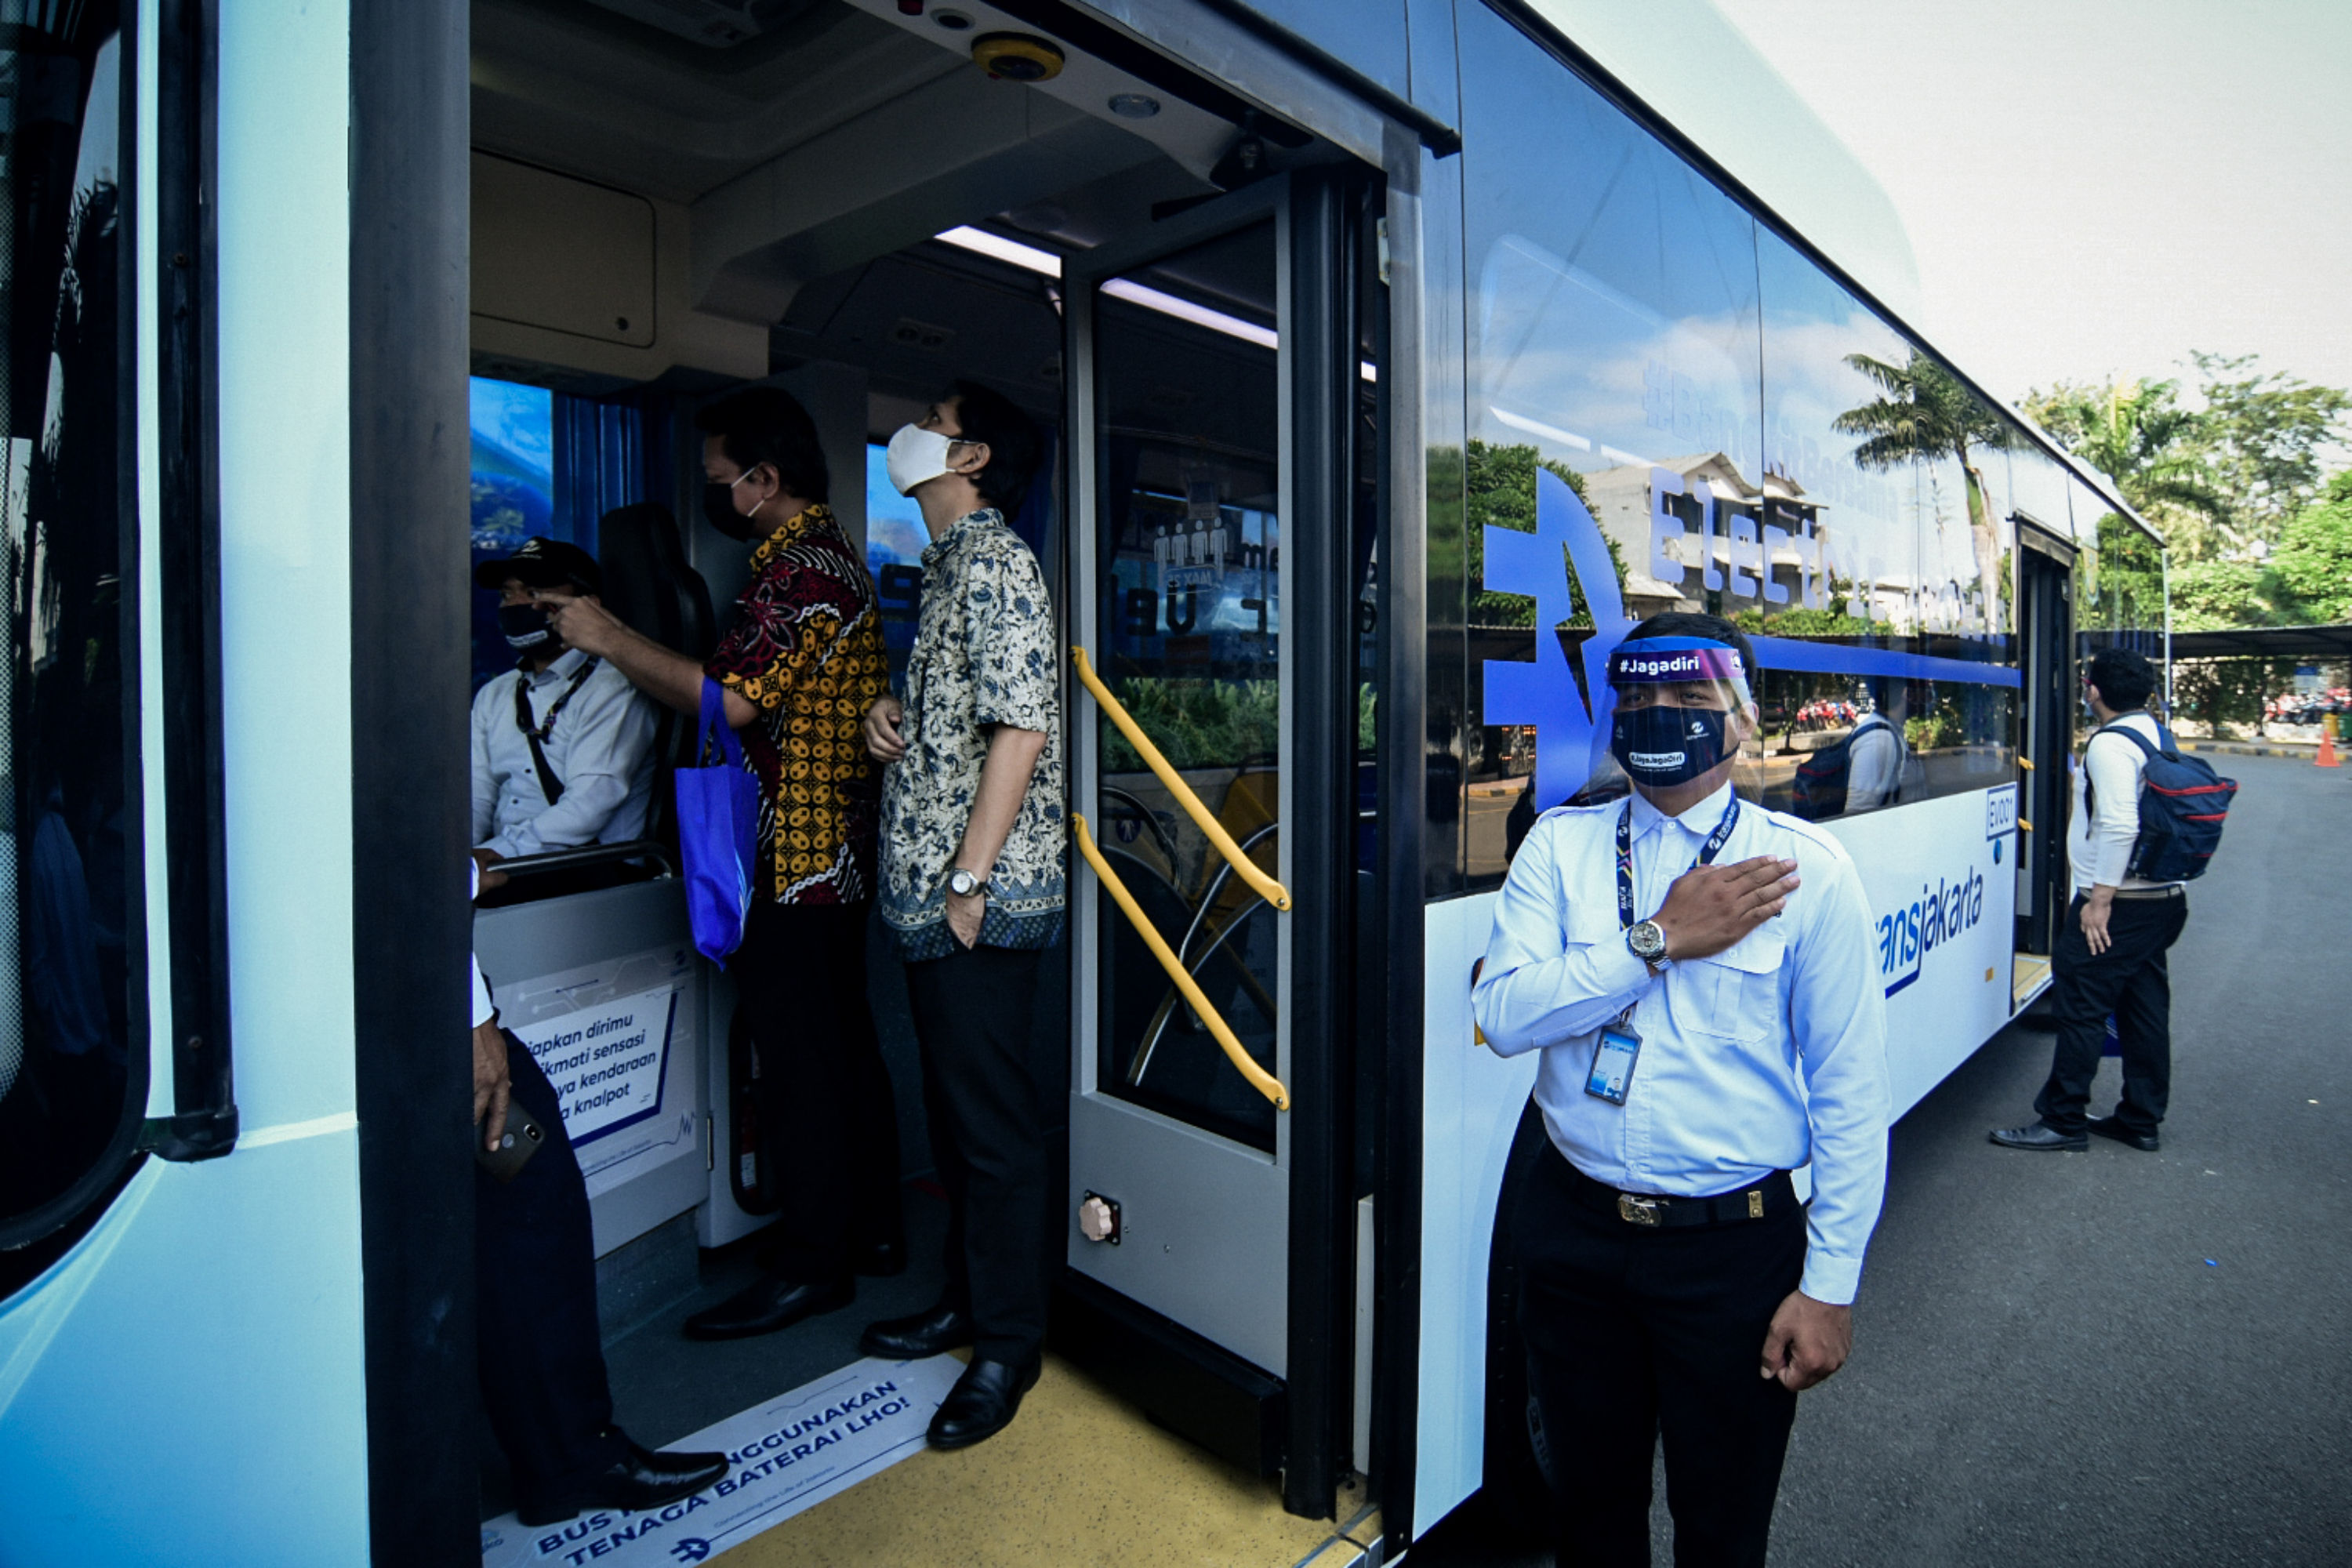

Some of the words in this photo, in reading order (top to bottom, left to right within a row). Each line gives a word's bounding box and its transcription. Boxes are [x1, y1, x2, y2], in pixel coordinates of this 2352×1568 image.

[1650, 466, 1886, 621] Electric
[1620, 655, 1700, 676] #Jagadiri
[1876, 865, 1984, 988] ansjakarta
[528, 1031, 582, 1057] iapkan
[586, 1014, 633, 1039] dirimu
[541, 1047, 590, 1076] ikmati
[593, 1029, 646, 1061] sensasi
[579, 1051, 656, 1090] kendaraan
[574, 1083, 630, 1116] knalpot
[537, 1512, 612, 1555] BUS
[726, 1380, 898, 1466] NGGUNAKAN
[564, 1494, 710, 1567] TENAGA
[713, 1428, 843, 1497] BATERAI
[845, 1396, 912, 1434] LHO!
